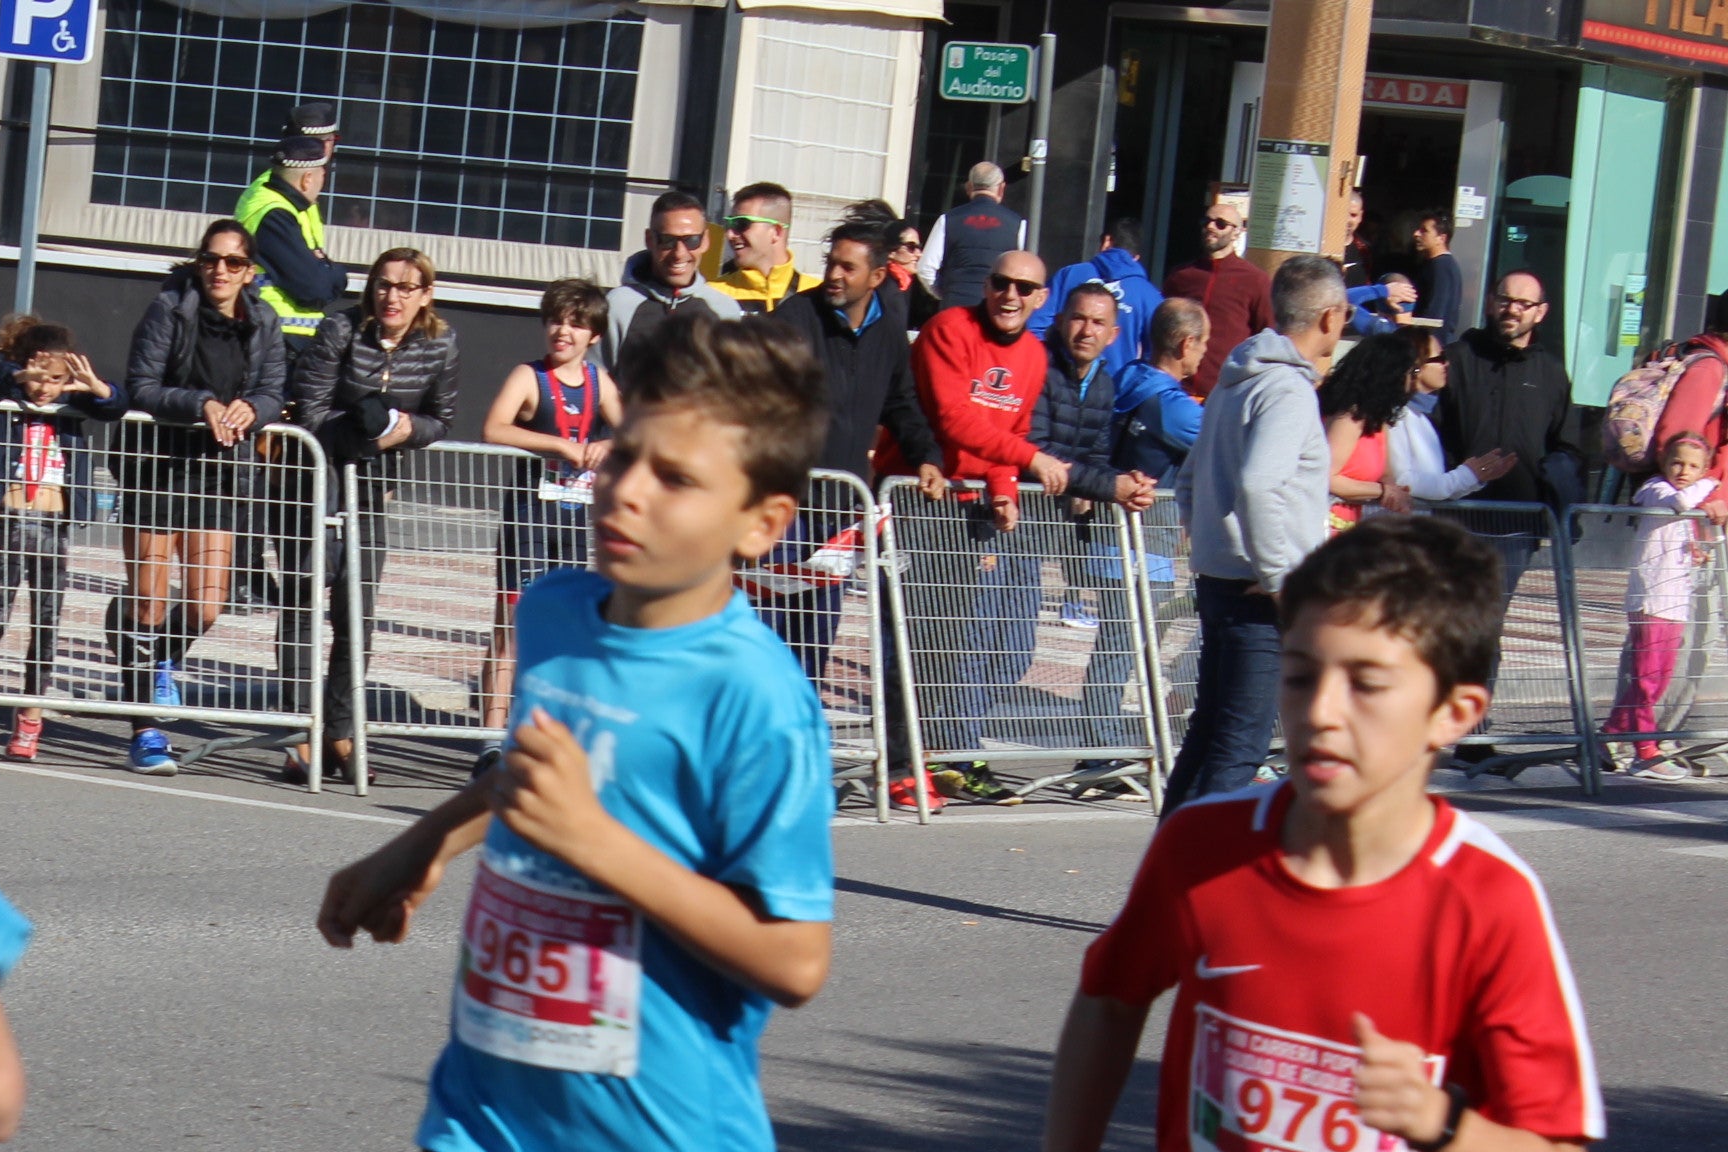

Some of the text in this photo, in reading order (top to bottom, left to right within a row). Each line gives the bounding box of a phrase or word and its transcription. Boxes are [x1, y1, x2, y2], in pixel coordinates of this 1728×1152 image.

[12, 0, 73, 45] P
[974, 47, 1019, 65] Pasaje
[983, 65, 1002, 78] del
[947, 77, 1024, 98] Auditorio
[478, 919, 569, 993] 965
